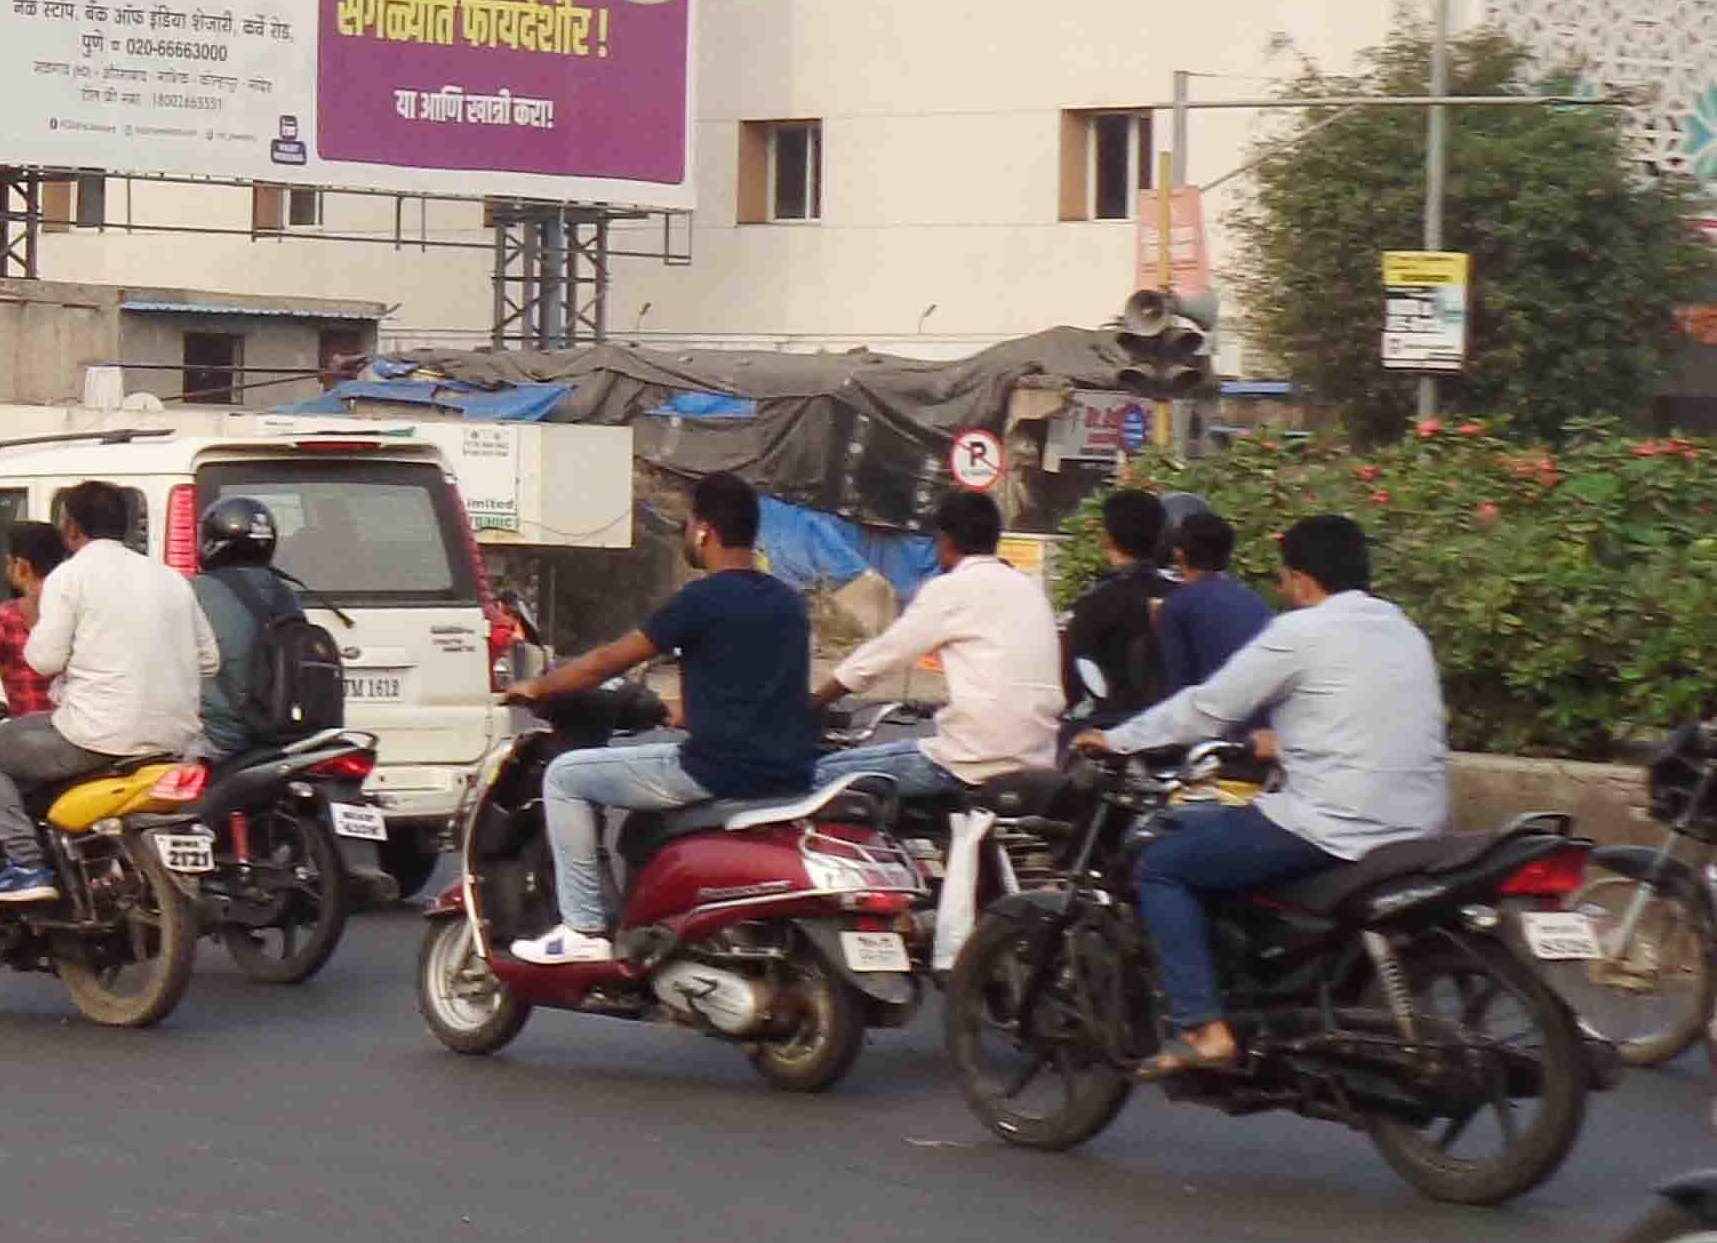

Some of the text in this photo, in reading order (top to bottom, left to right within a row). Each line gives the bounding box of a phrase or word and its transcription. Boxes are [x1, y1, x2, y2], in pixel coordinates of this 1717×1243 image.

[82, 28, 104, 59] पुणे
[394, 89, 416, 120] या
[420, 84, 463, 123] आणि
[465, 87, 511, 125] खात्री
